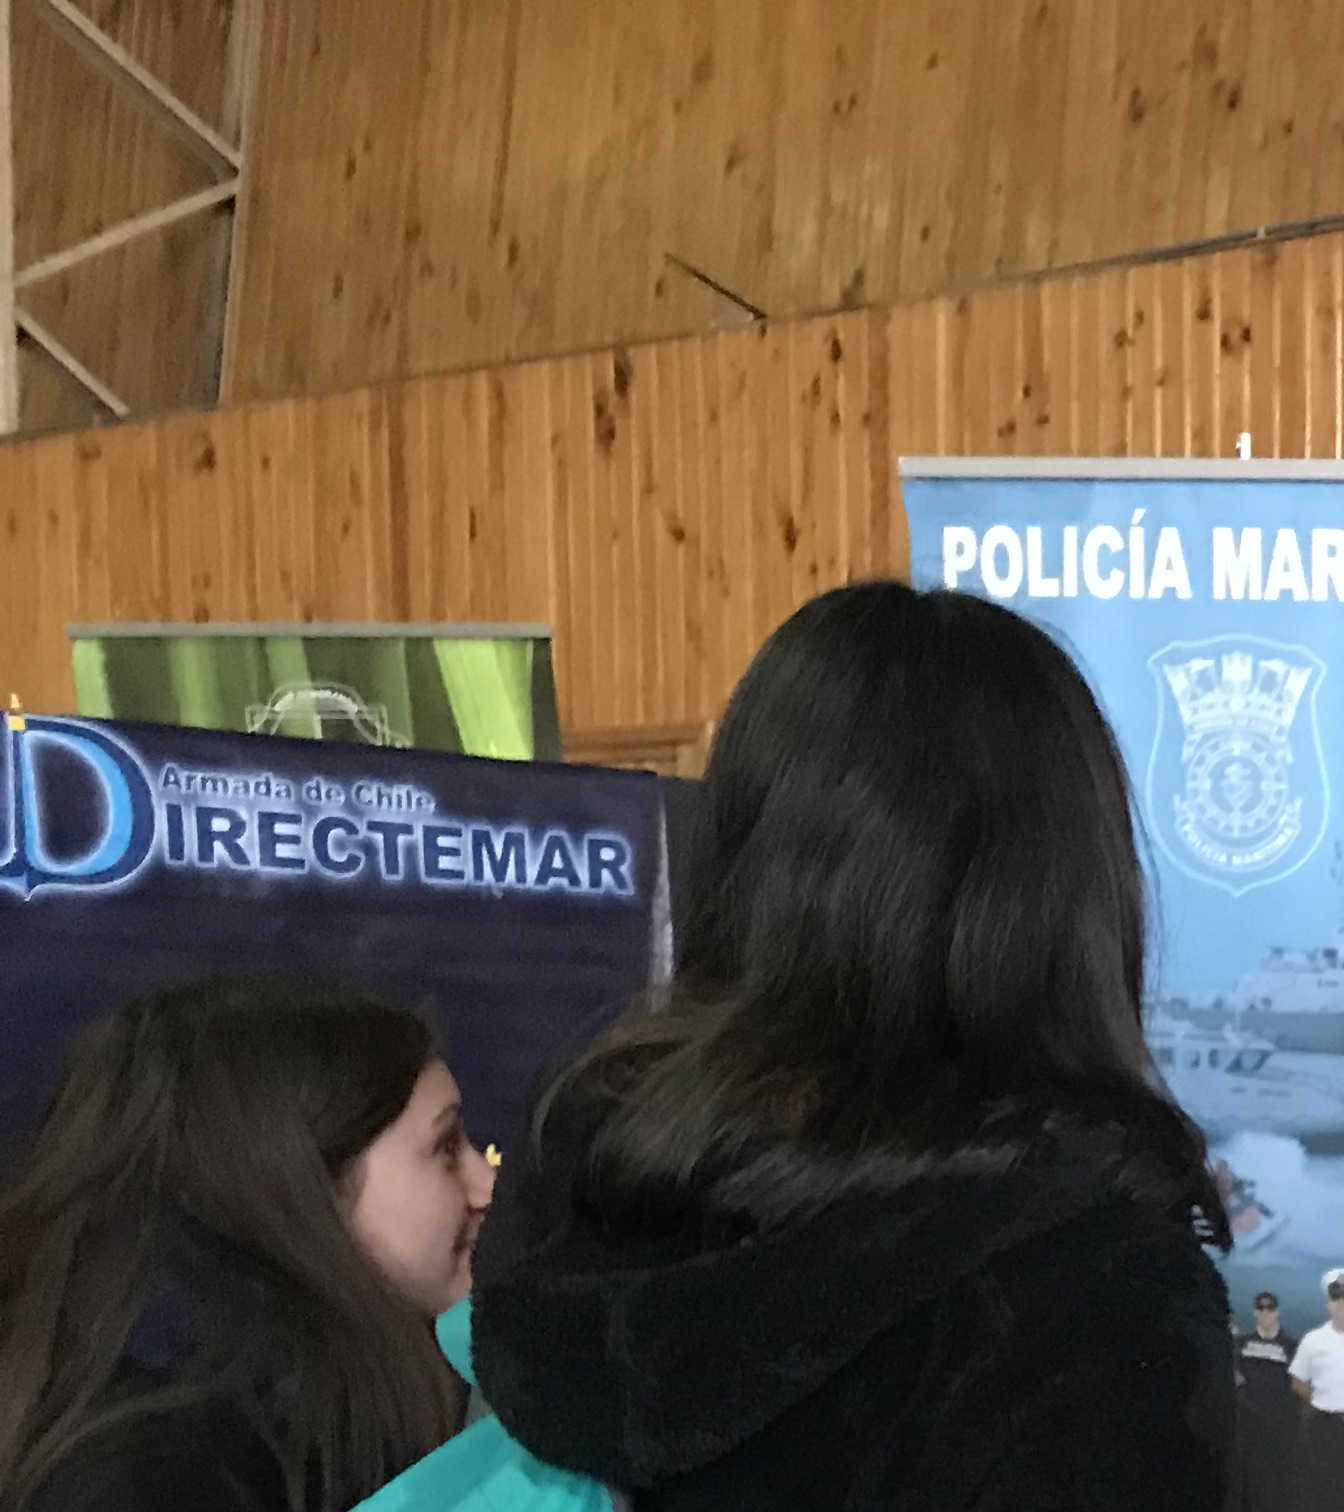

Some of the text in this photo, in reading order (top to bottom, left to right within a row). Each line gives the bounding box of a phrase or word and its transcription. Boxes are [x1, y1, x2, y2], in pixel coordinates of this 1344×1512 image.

[941, 508, 1193, 600] POLICÍA
[160, 764, 440, 813] Armada de Chile
